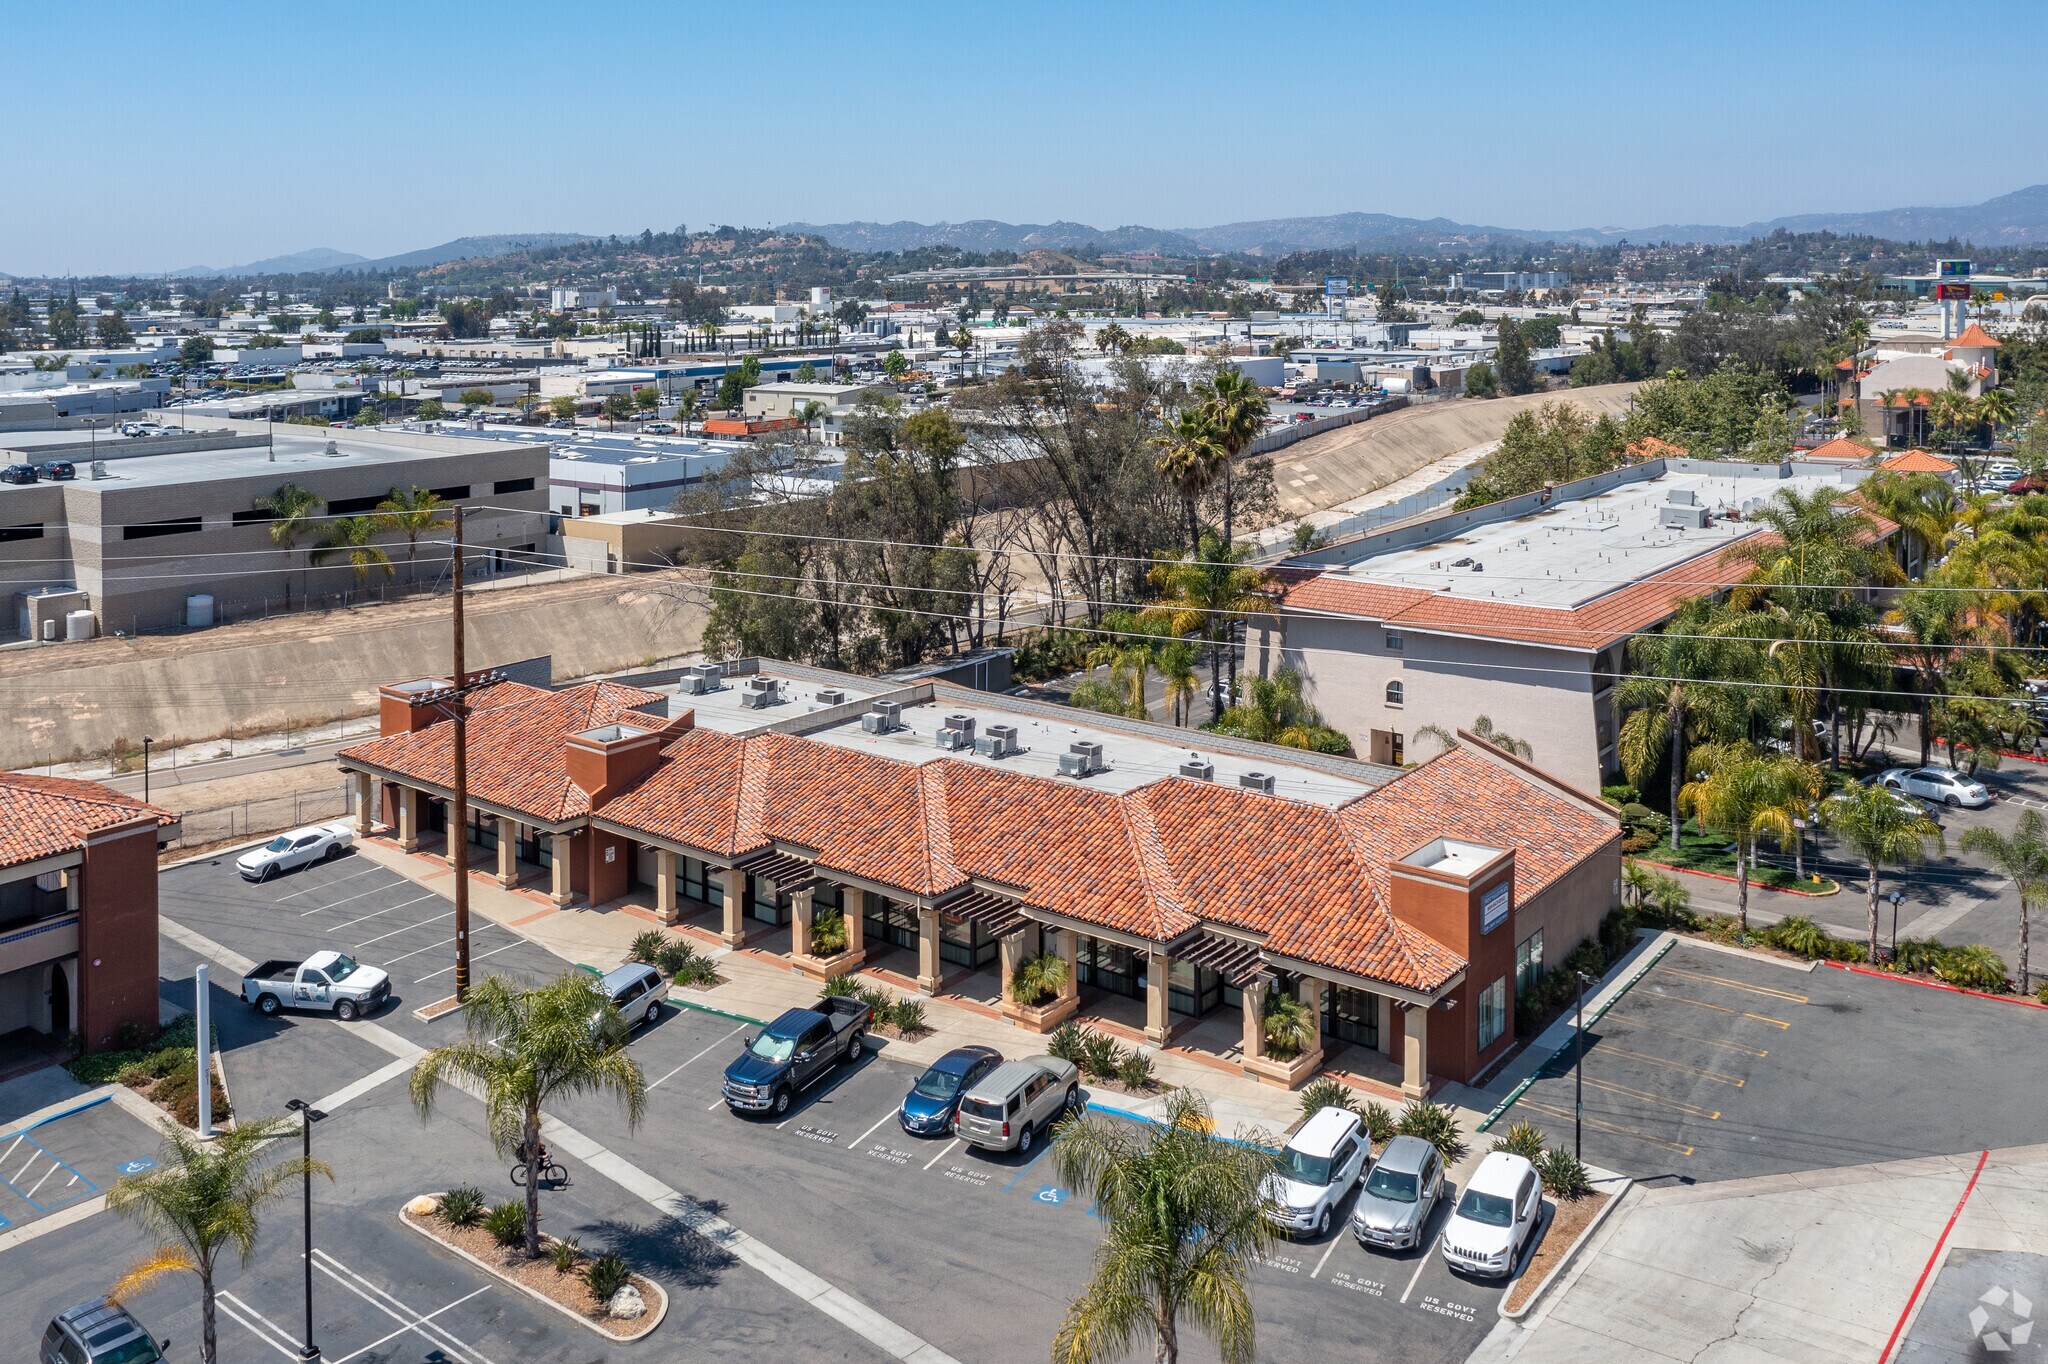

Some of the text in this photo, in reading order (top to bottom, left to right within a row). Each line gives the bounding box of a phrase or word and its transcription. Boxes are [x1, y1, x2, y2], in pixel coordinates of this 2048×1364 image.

[794, 1129, 834, 1144] RESERVED
[816, 1129, 839, 1138] GOVT
[866, 1149, 908, 1164] RESERVED
[890, 1149, 913, 1159] GOVT
[943, 1170, 986, 1186] RESERVED
[950, 1165, 991, 1180] US GOVT
[1275, 1255, 1303, 1267] GOVT
[1330, 1277, 1383, 1297] RESERVED
[1336, 1272, 1386, 1290] US GOVT
[1419, 1302, 1474, 1322] RESERVED
[1424, 1295, 1477, 1315] US GOVT
